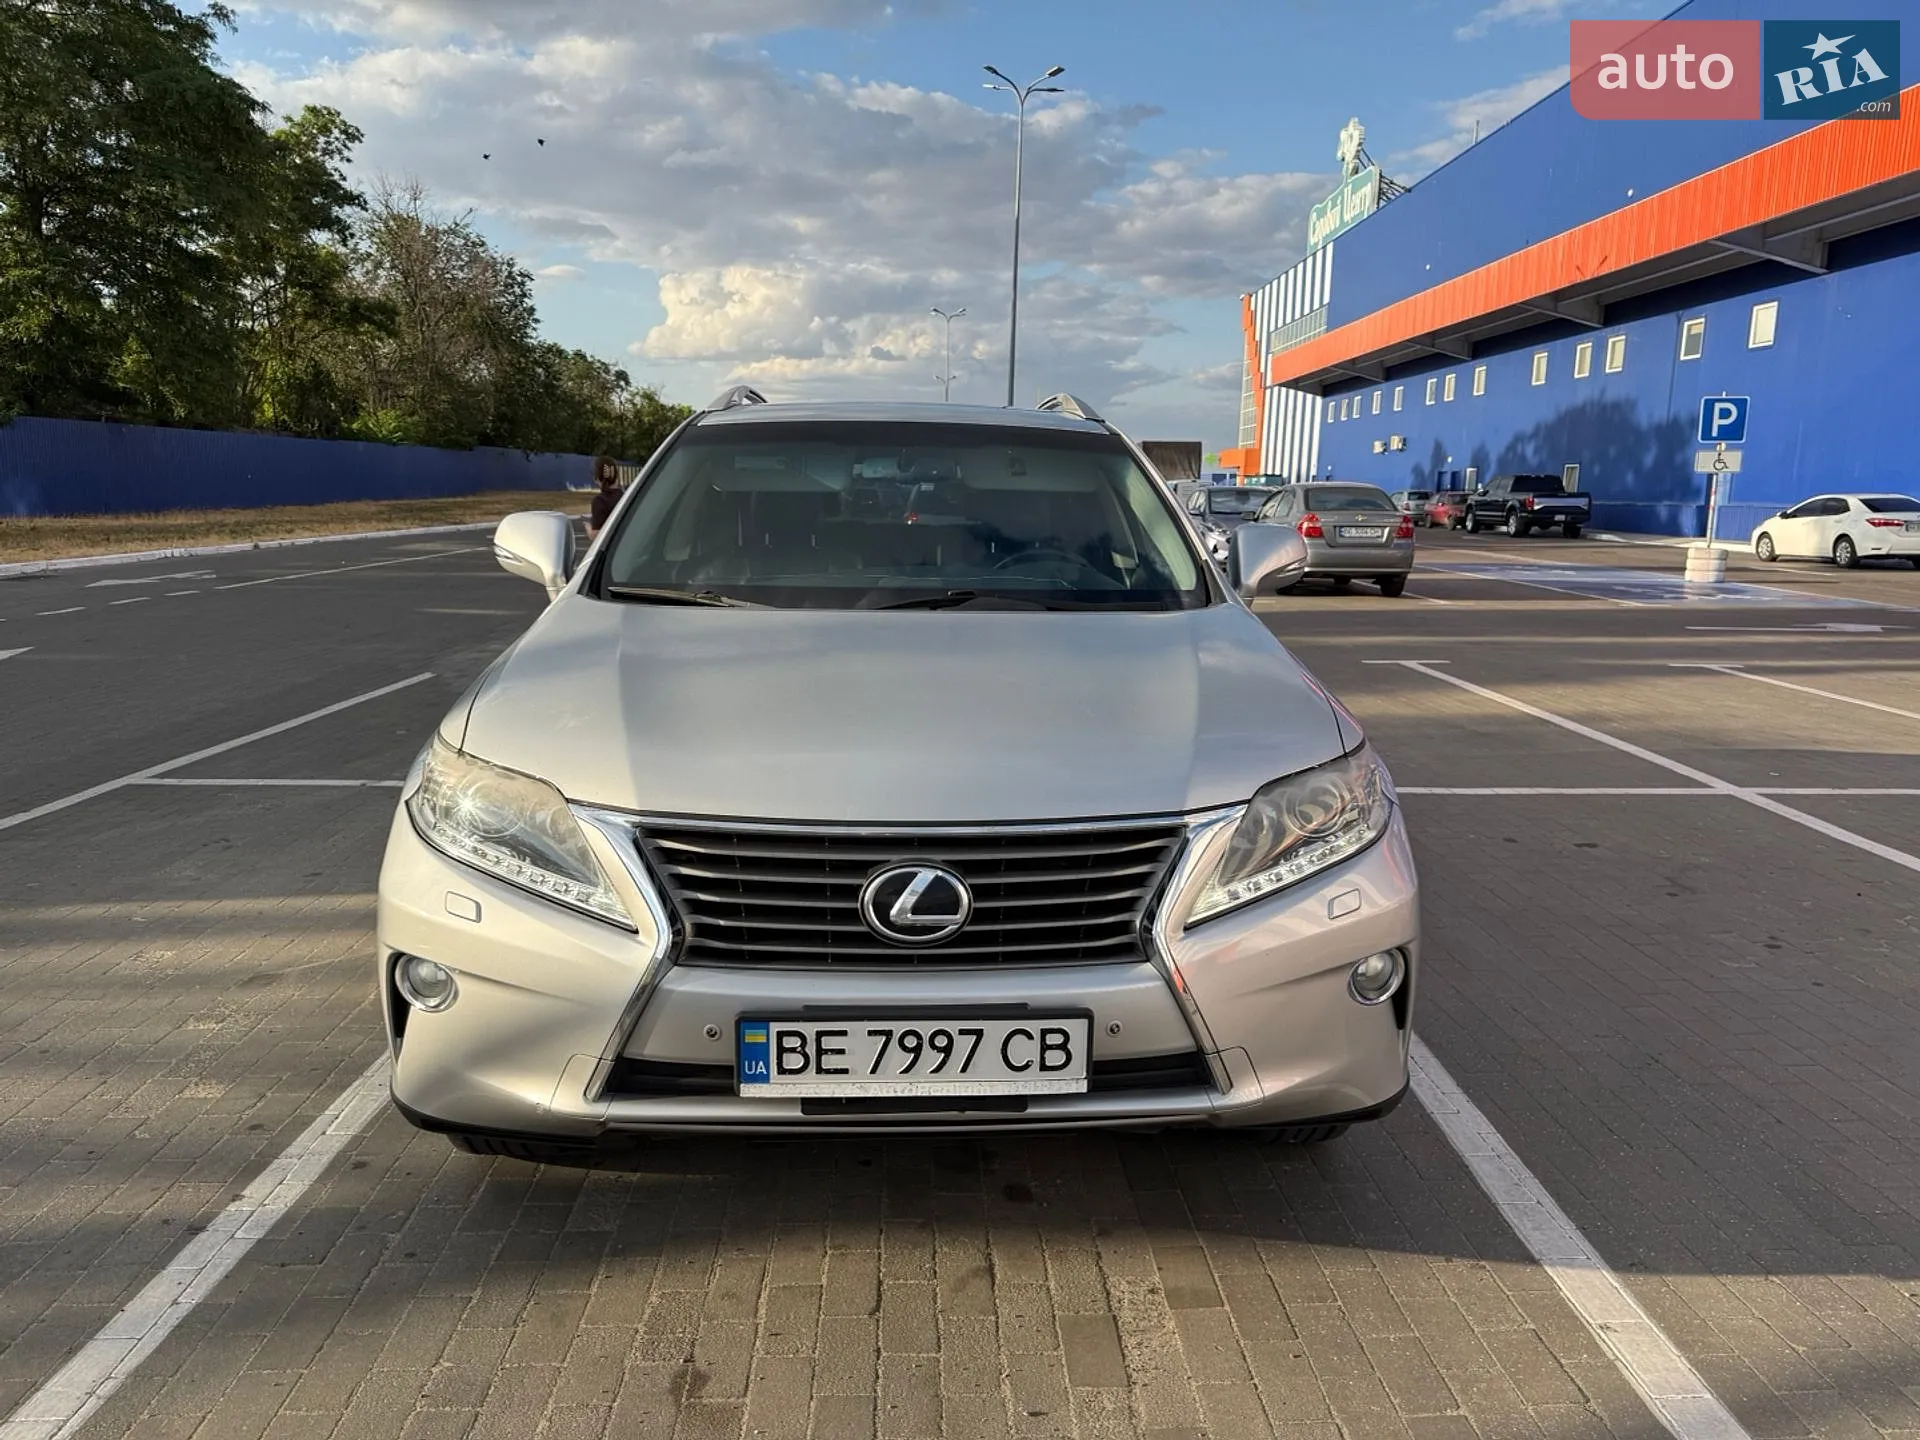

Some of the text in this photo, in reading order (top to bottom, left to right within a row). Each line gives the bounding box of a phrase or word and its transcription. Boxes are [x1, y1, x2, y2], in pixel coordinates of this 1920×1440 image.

[1711, 402, 1738, 437] P
[745, 1059, 767, 1075] UA
[775, 1027, 1073, 1075] BE 7997 CB
